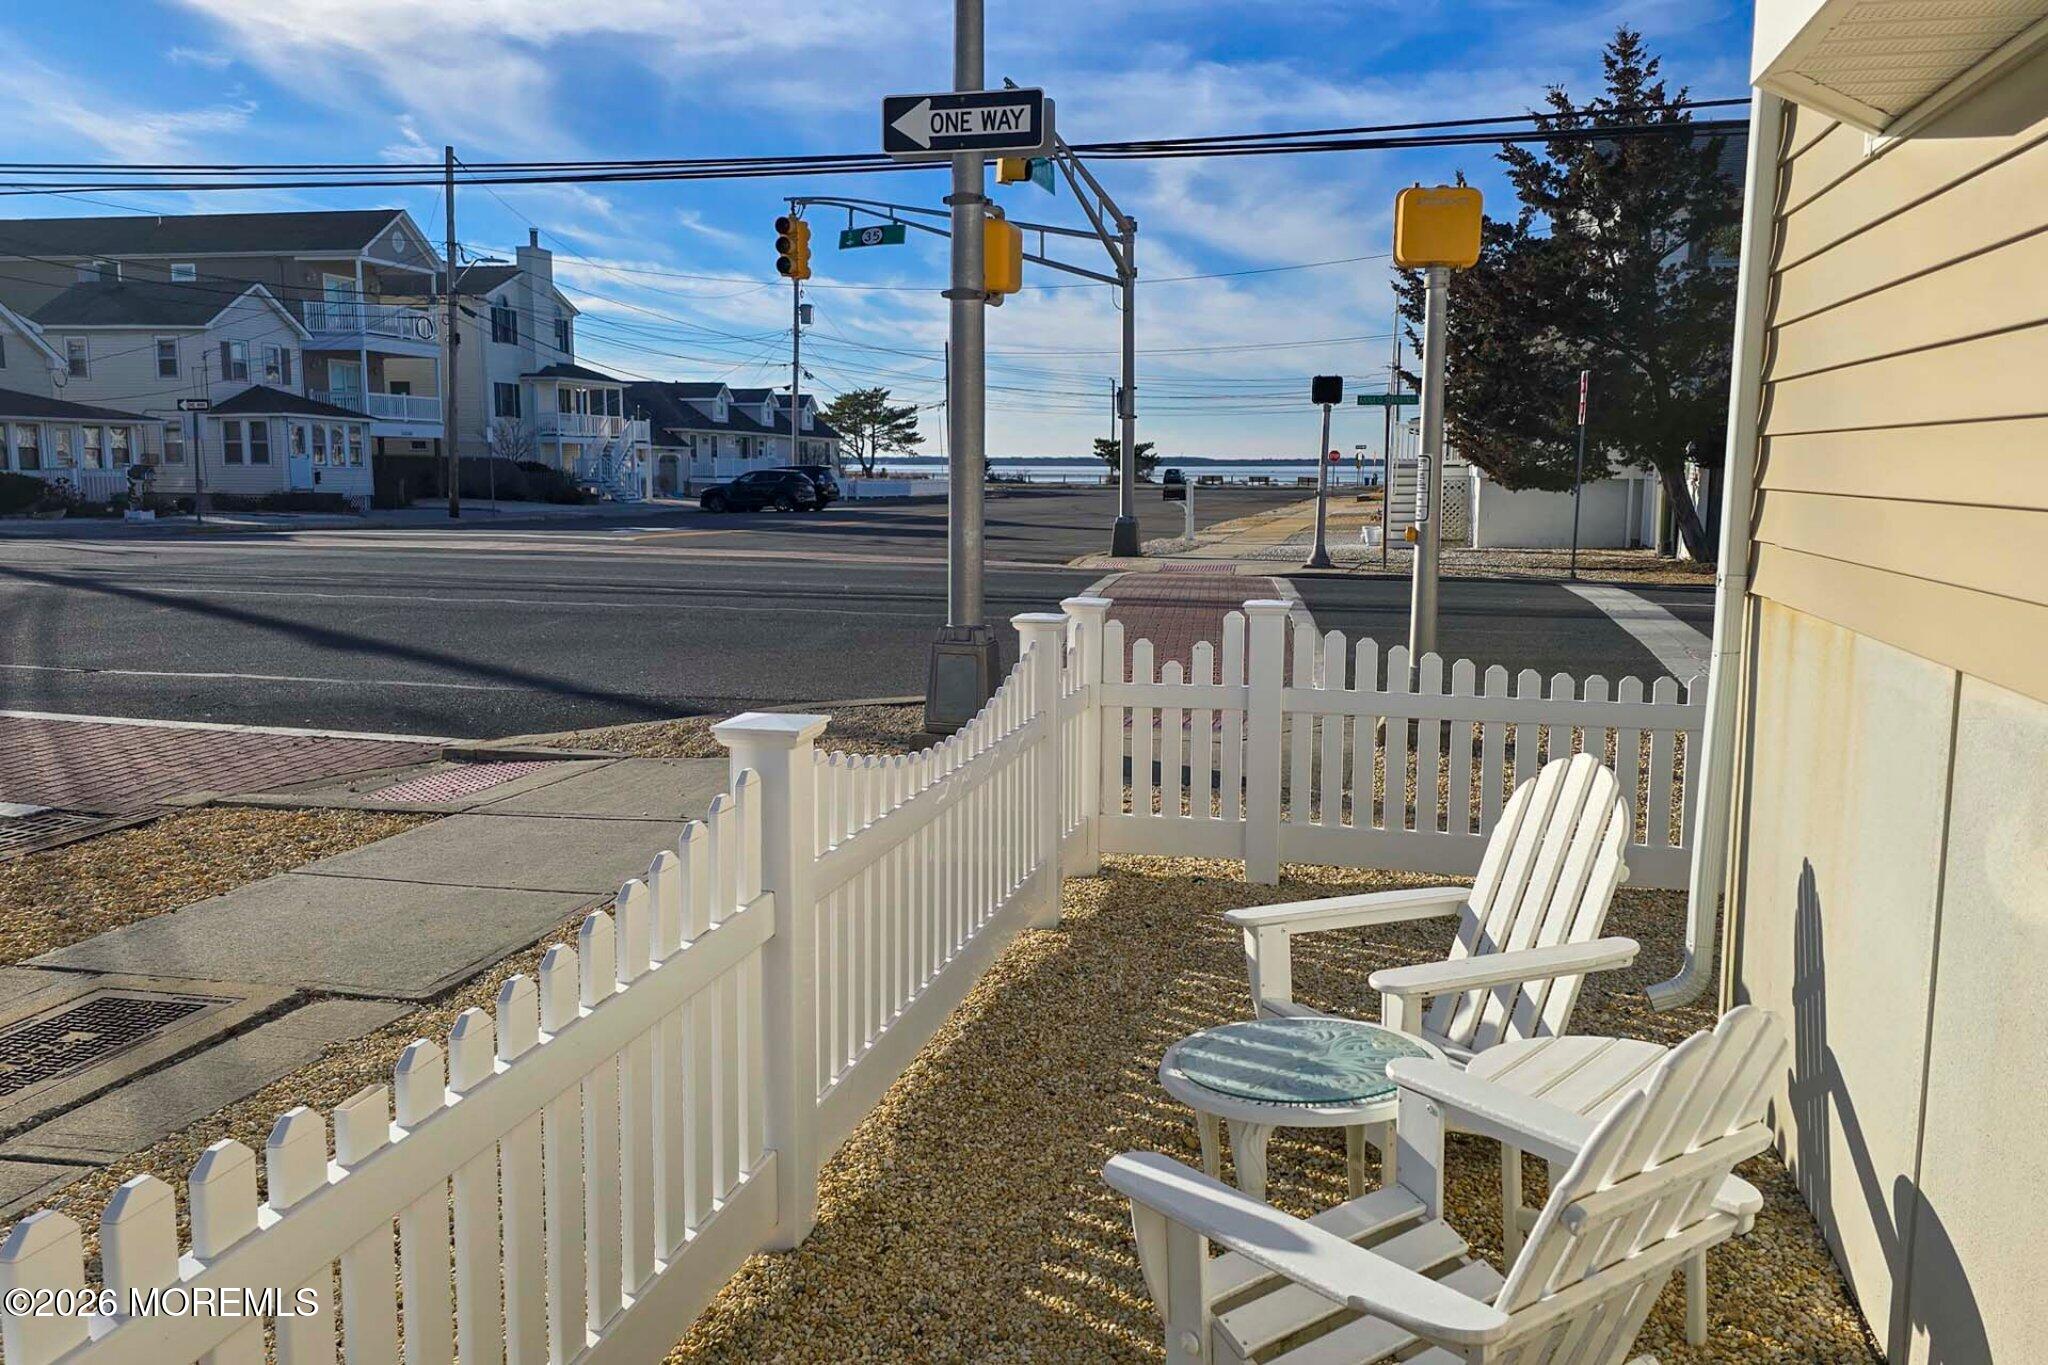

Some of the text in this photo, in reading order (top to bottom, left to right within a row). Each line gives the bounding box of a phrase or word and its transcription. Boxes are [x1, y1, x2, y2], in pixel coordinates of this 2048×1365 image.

[930, 108, 1024, 134] ONE WAY
[863, 229, 881, 243] 35
